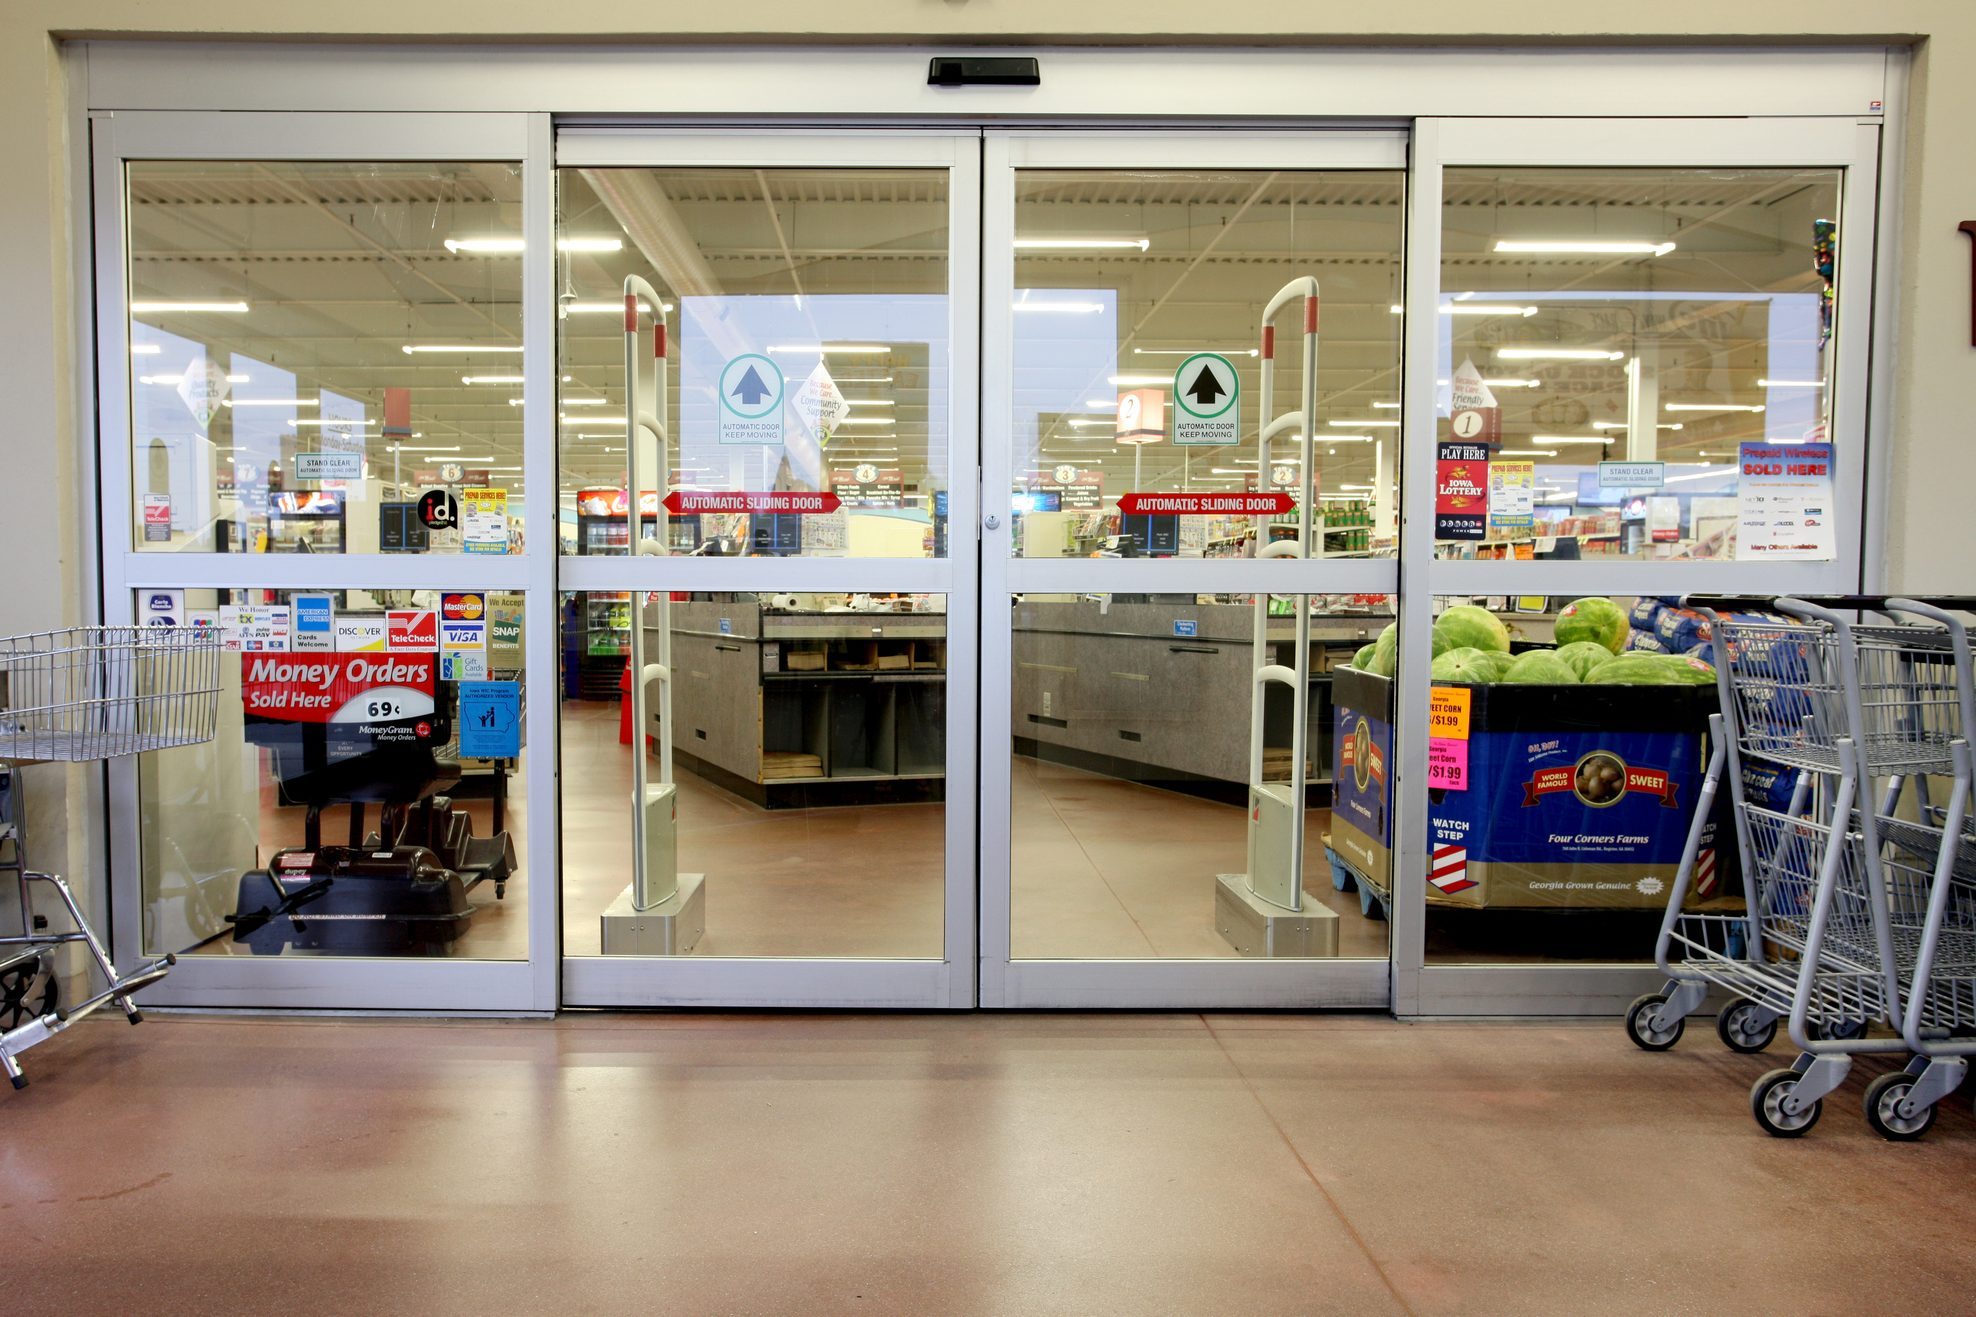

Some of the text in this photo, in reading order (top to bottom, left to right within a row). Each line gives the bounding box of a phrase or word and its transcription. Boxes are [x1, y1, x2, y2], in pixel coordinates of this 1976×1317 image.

[809, 379, 832, 389] Because
[800, 396, 842, 410] Community
[1452, 393, 1485, 405] Friendly
[807, 406, 835, 418] Support
[1126, 398, 1134, 419] 2
[1462, 415, 1473, 434] 1
[725, 431, 778, 439] KEEP MOVING
[1441, 448, 1486, 460] PLAY HERE
[1742, 448, 1829, 460] Prepaid Wireless
[448, 468, 455, 478] 6
[1491, 464, 1505, 472] PREPAID
[1506, 464, 1521, 472] SERVICES
[1743, 463, 1827, 476] SOLD HERE
[862, 469, 869, 479] 4
[1062, 470, 1069, 480] 3
[1279, 471, 1286, 481] 2
[1439, 484, 1483, 496] LOTTERY
[464, 491, 479, 500] PREPAID
[479, 491, 496, 500] SERVICES
[681, 496, 823, 510] AUTOMATIC SLIDING DOOR
[1136, 498, 1198, 511] AUTOMATIC
[1200, 498, 1244, 511] SLIDING
[1246, 498, 1276, 511] DOOR
[443, 602, 482, 611] MasterCard
[489, 598, 525, 607] We Accept
[297, 608, 329, 616] AMERICAN
[338, 627, 381, 636] DISCOVER
[449, 630, 478, 642] VISA
[492, 626, 520, 636] SNAP
[391, 634, 435, 643] TeleCheck
[464, 657, 478, 665] Gift
[464, 664, 484, 672] Cards
[249, 657, 428, 690] Money Orders
[250, 690, 332, 708] Sold Here
[367, 701, 401, 717] 69¢
[1443, 704, 1462, 714] CORN
[358, 725, 413, 736] MoneyGram
[377, 734, 397, 742] Money
[1440, 755, 1457, 763] Corn
[1541, 772, 1568, 782] WORLD
[1629, 774, 1665, 789] SWEET
[1537, 779, 1568, 789] FAMOUS
[1432, 817, 1470, 831] WATCH
[1703, 823, 1717, 833] ATCH
[1436, 829, 1464, 840] STEP
[1548, 833, 1649, 844] Four Corners Farms
[1700, 833, 1715, 845] STEP
[1529, 881, 1564, 890] Georgia
[1565, 881, 1594, 889] Grown
[1595, 881, 1632, 890] Genuine
